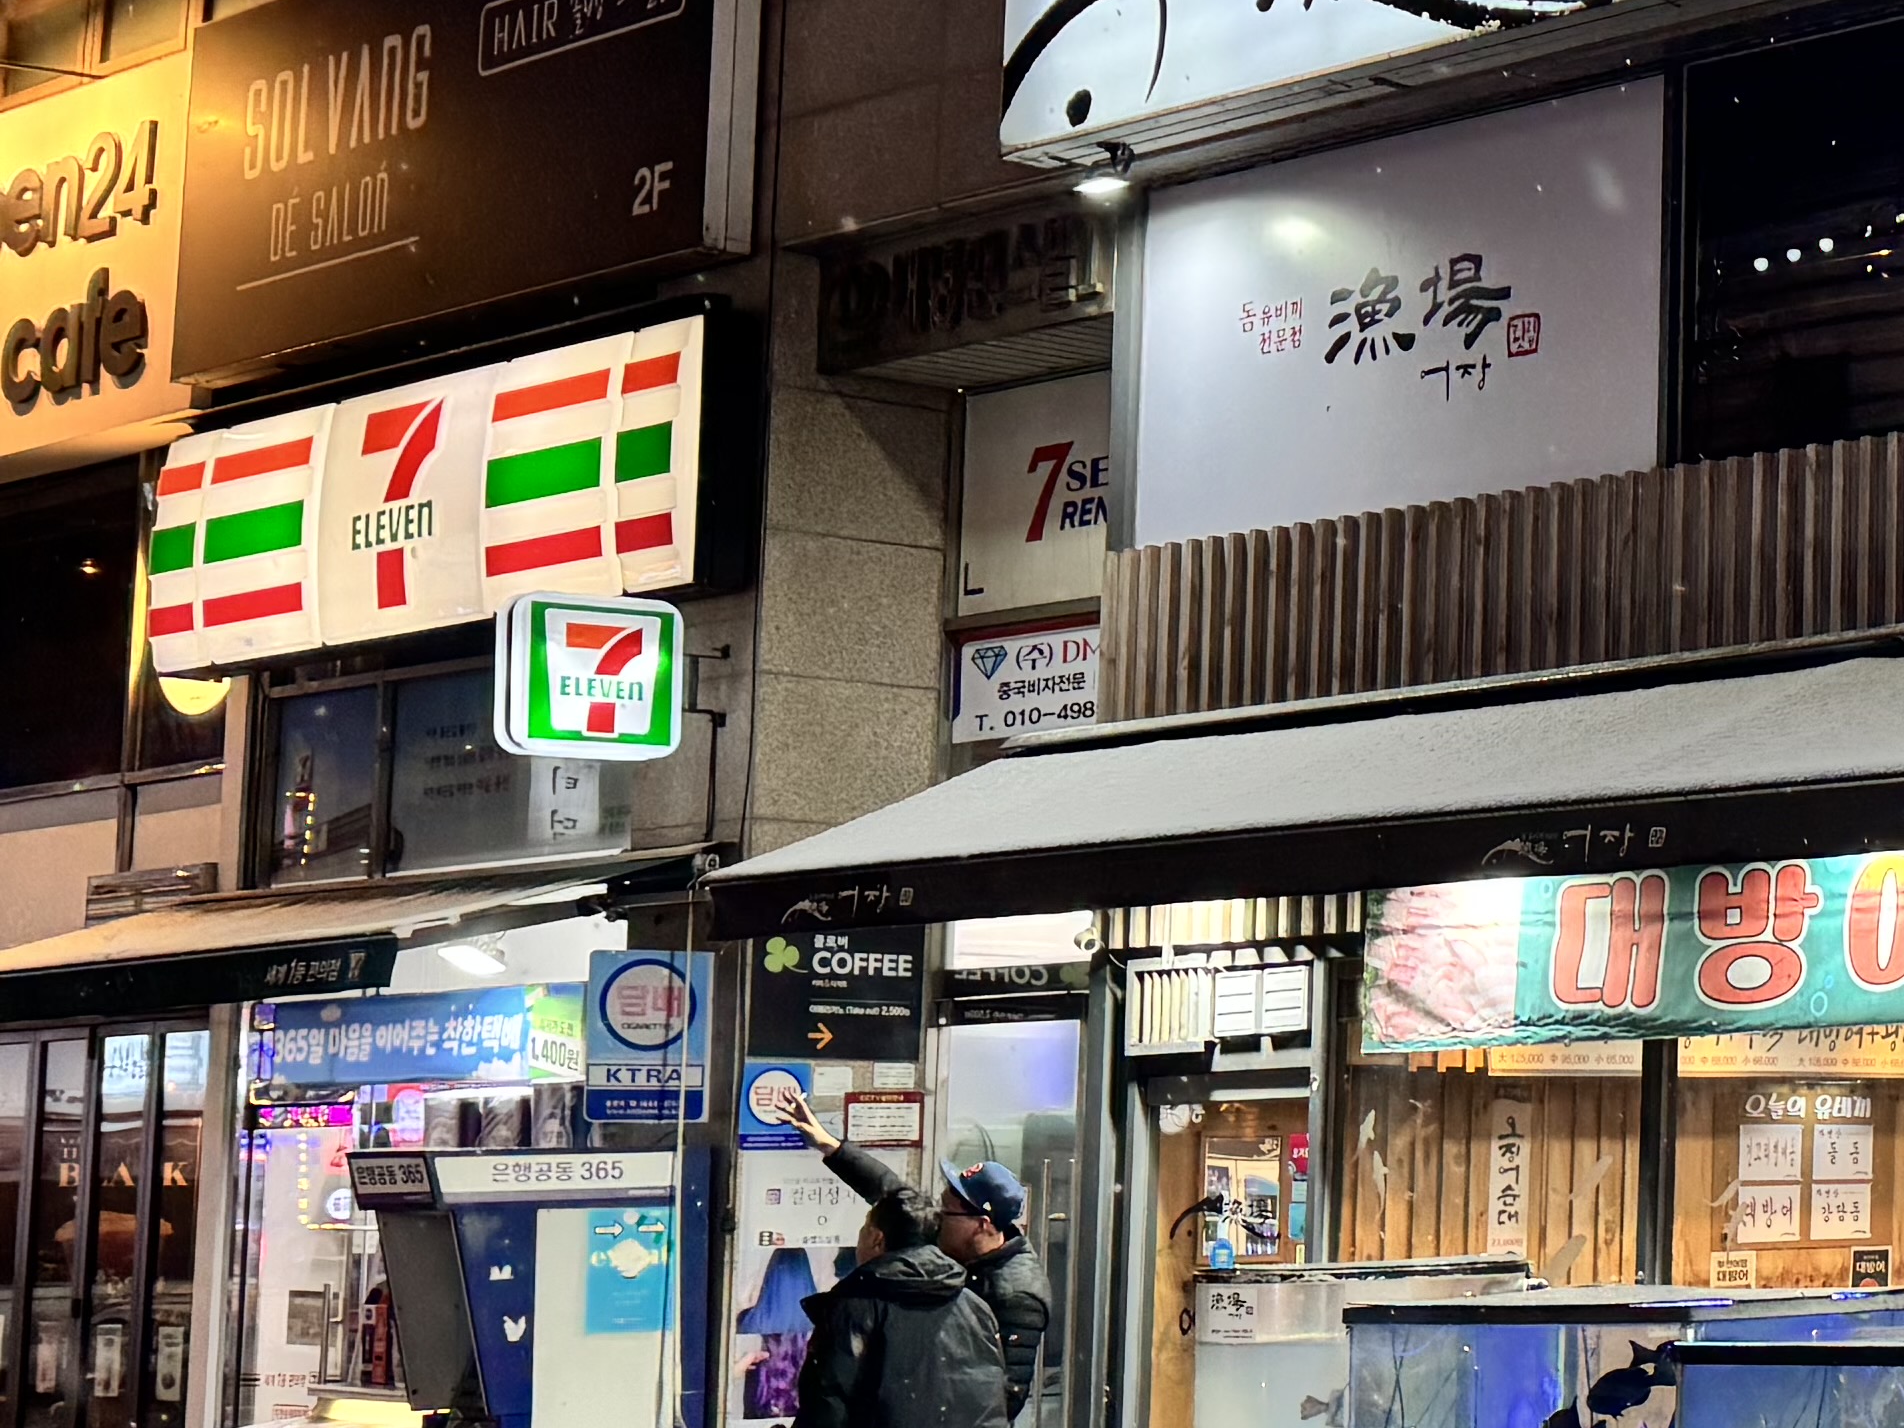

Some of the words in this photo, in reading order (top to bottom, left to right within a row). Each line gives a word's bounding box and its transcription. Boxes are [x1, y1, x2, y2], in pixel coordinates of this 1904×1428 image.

[494, 0, 560, 56] HAIR
[243, 24, 431, 180] SOLVANG
[633, 160, 674, 217] 2F
[1325, 253, 1511, 365] 漁場
[3, 267, 149, 413] cafe
[1025, 442, 1074, 543] 7
[1015, 642, 1053, 671] (주)
[812, 952, 913, 977] COFFEE
[617, 985, 682, 1019] 담배
[328, 1024, 373, 1062] 마음을
[376, 1019, 439, 1057] 이어주는
[1746, 1094, 1806, 1119] 오늘의
[1815, 1094, 1872, 1119] 유비끼
[492, 1163, 574, 1183] 은행공동
[580, 1160, 624, 1182] 365
